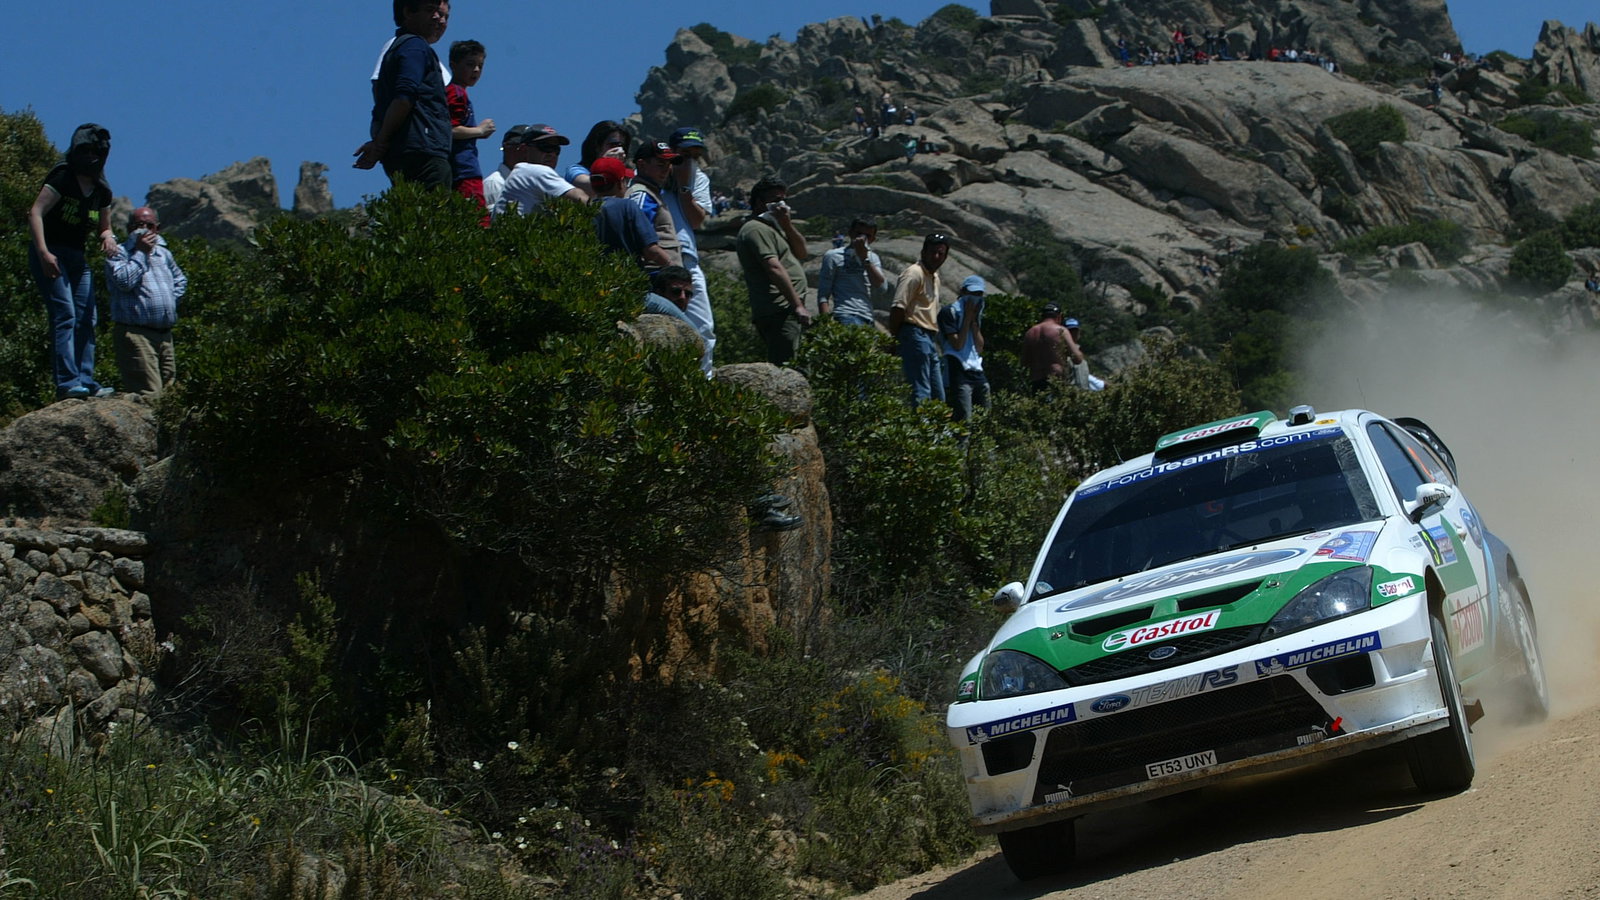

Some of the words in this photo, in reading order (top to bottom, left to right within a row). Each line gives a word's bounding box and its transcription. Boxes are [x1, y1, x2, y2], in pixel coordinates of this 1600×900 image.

[1107, 431, 1311, 489] FordTeamRS.com
[1130, 613, 1213, 645] Castrol
[1288, 635, 1375, 666] MICHELIN
[1098, 698, 1123, 711] Ford
[991, 707, 1070, 736] MICHELIN
[1149, 759, 1182, 778] ET53
[1187, 751, 1213, 770] UNY
